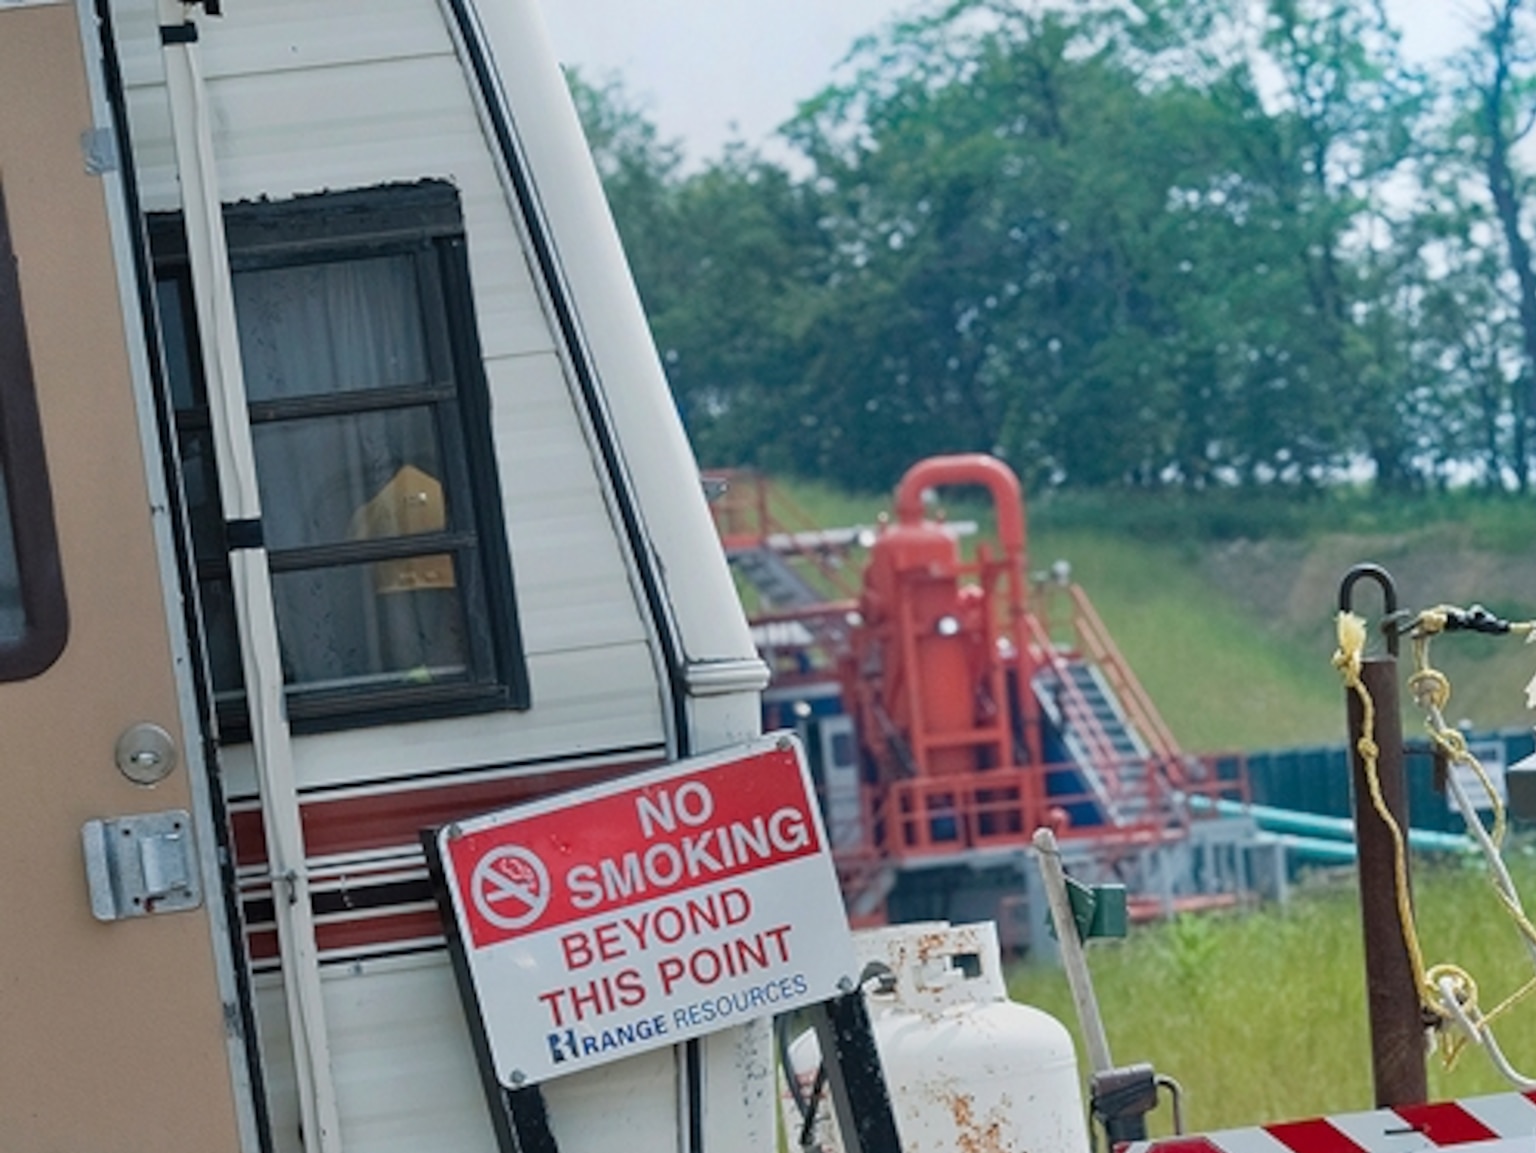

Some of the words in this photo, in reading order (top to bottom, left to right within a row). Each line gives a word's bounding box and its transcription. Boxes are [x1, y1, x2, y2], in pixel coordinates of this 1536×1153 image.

[635, 781, 714, 838] NO
[566, 808, 809, 909] SMOKING
[561, 887, 751, 971] BEYOND
[540, 971, 646, 1028] THIS
[658, 925, 792, 995] POINT
[583, 1016, 668, 1056] RANGE
[673, 974, 808, 1029] RESOURCES
